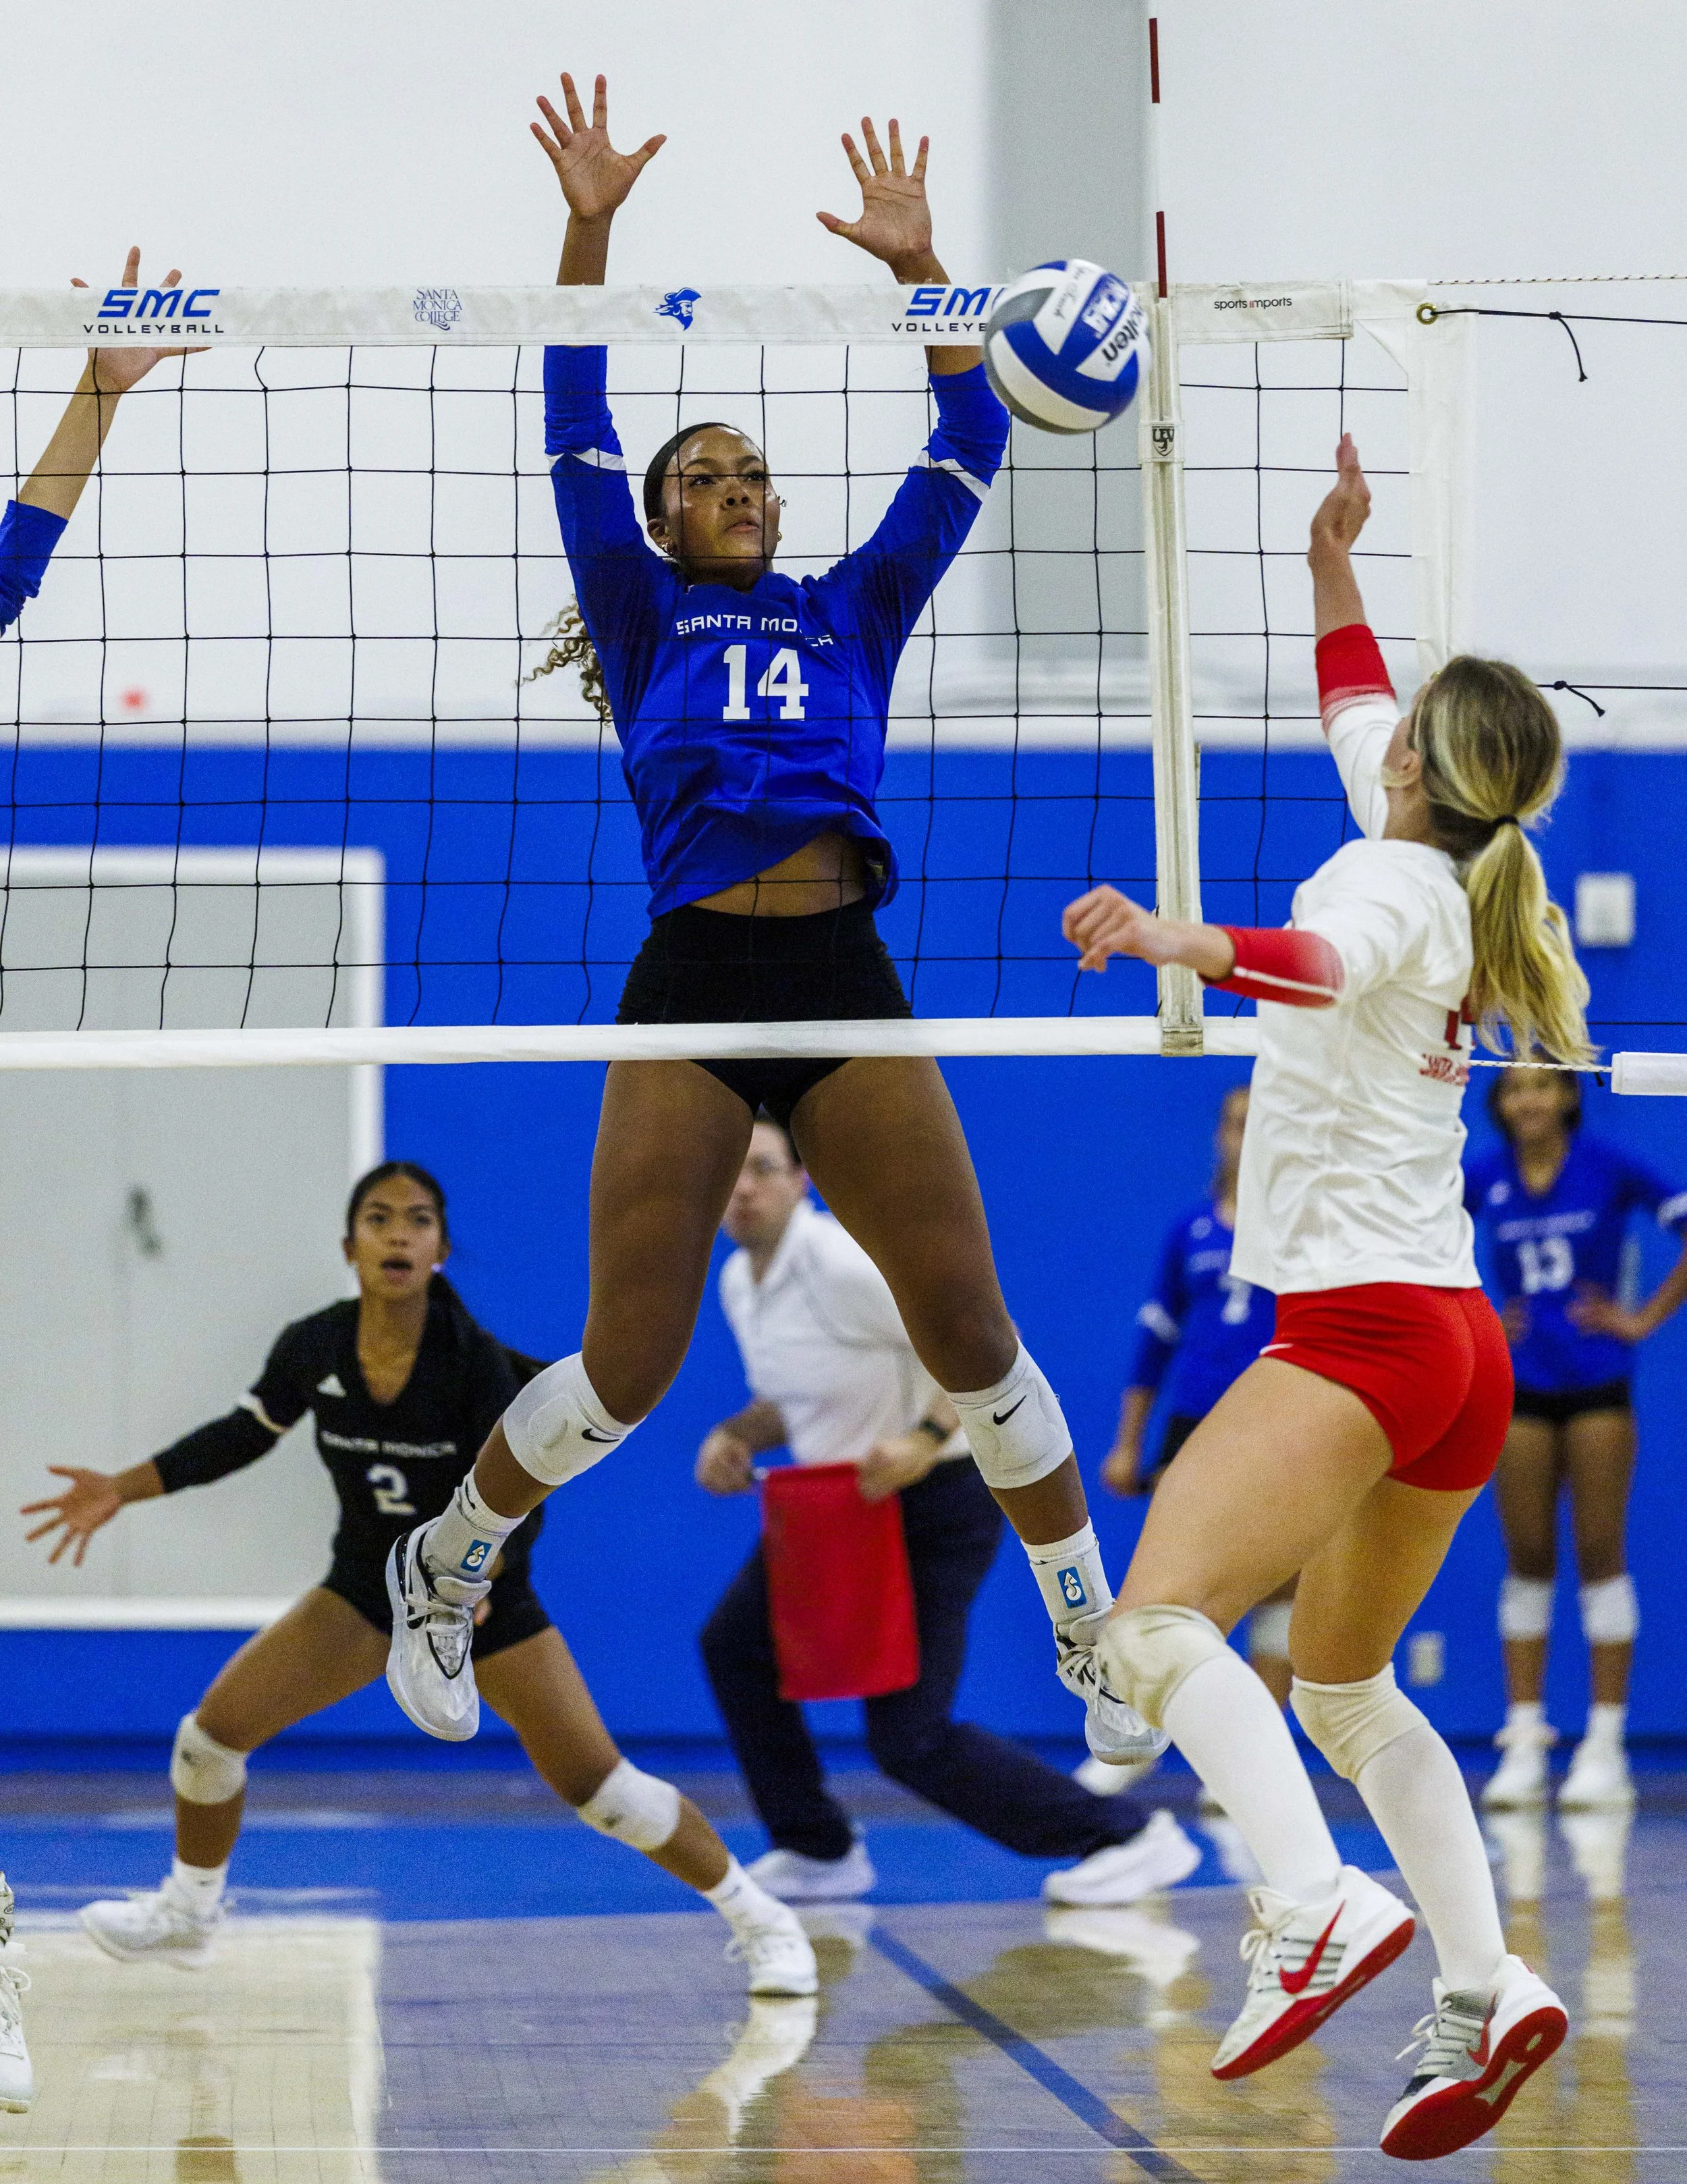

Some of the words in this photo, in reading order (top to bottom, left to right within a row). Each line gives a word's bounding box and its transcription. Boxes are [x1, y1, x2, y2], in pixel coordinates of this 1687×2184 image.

[97, 289, 221, 318] SMC
[413, 300, 462, 310] MONICA
[416, 289, 458, 300] SANTA
[906, 288, 1004, 316] SM
[1214, 299, 1248, 310] sports
[83, 325, 225, 333] VOLLEYBALL
[415, 310, 460, 331] COLLEGE
[676, 614, 751, 635] SANTA
[723, 645, 809, 722] 14
[366, 1463, 417, 1515] 2
